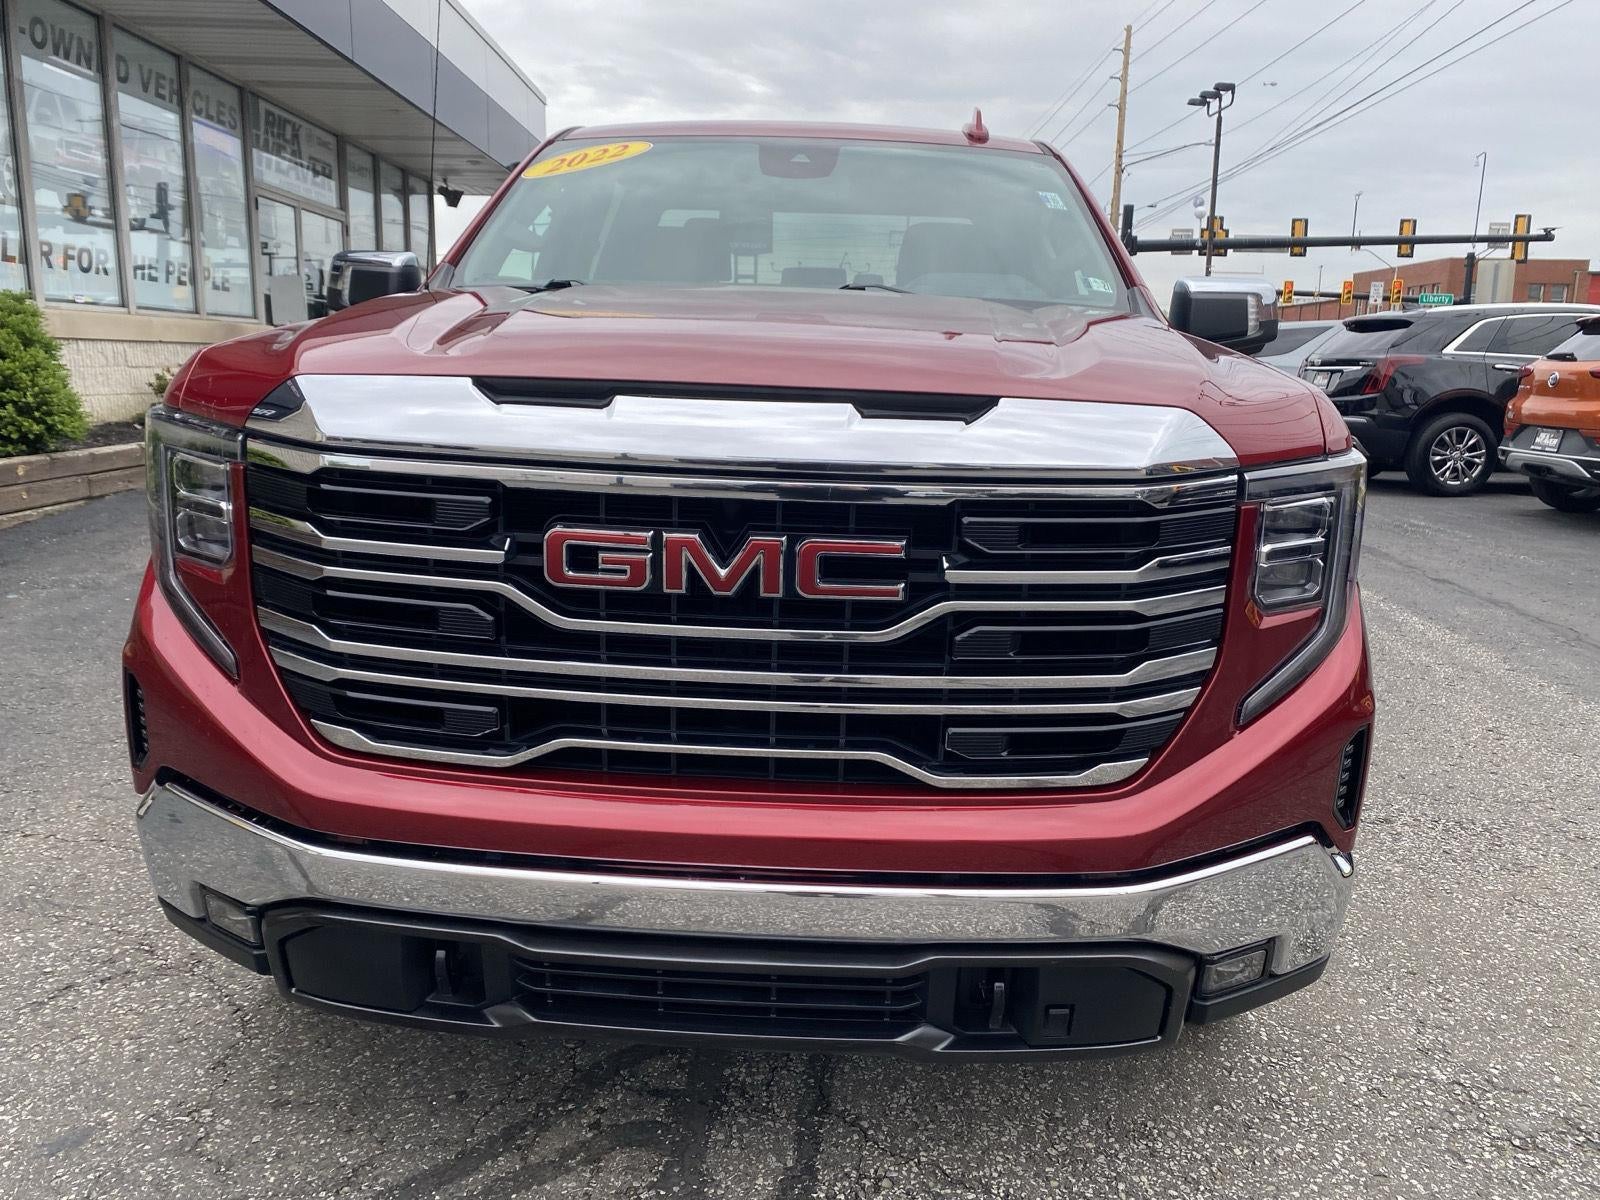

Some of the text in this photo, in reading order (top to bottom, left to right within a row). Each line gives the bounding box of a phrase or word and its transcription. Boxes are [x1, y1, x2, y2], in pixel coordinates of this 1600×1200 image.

[544, 144, 630, 175] 2022
[62, 244, 109, 276] FOR
[1423, 293, 1450, 305] Liberty
[543, 523, 908, 601] GMC
